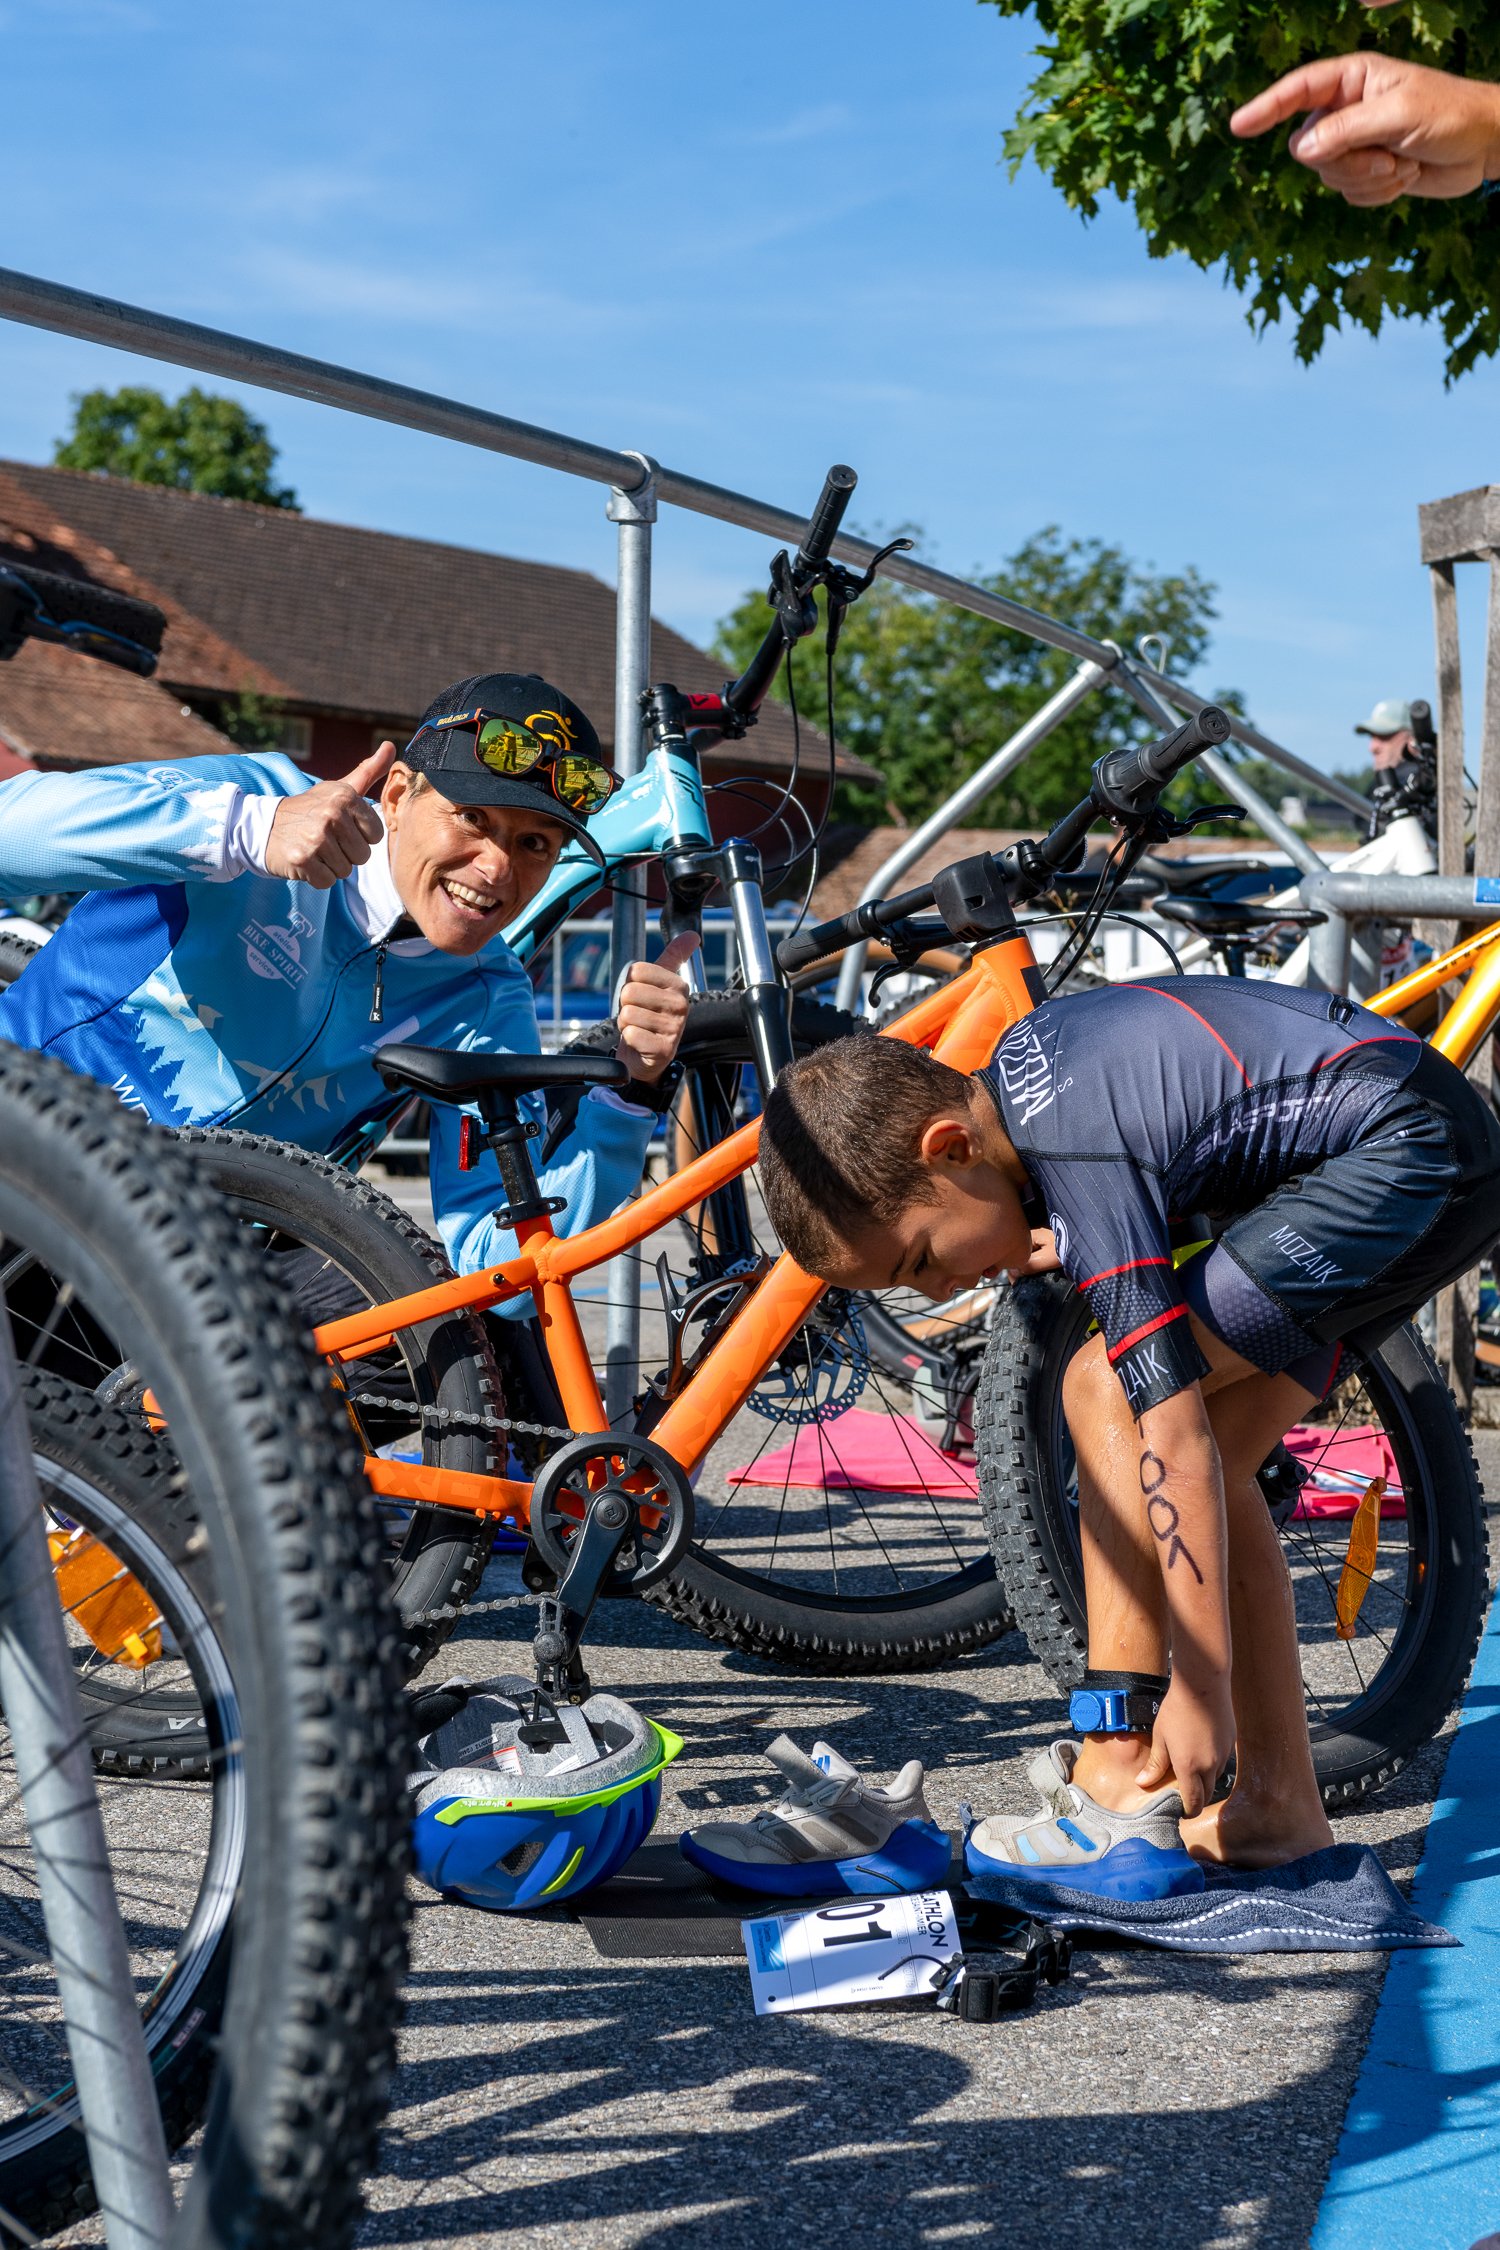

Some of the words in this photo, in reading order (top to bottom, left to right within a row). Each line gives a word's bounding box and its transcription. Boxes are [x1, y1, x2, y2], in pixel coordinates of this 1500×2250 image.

[243, 924, 270, 950] BIKE
[270, 947, 304, 983] SPIRIT
[249, 951, 275, 977] services
[273, 931, 295, 952] atelier
[1268, 1224, 1343, 1284] MOZAIK
[816, 1902, 893, 1948] 01
